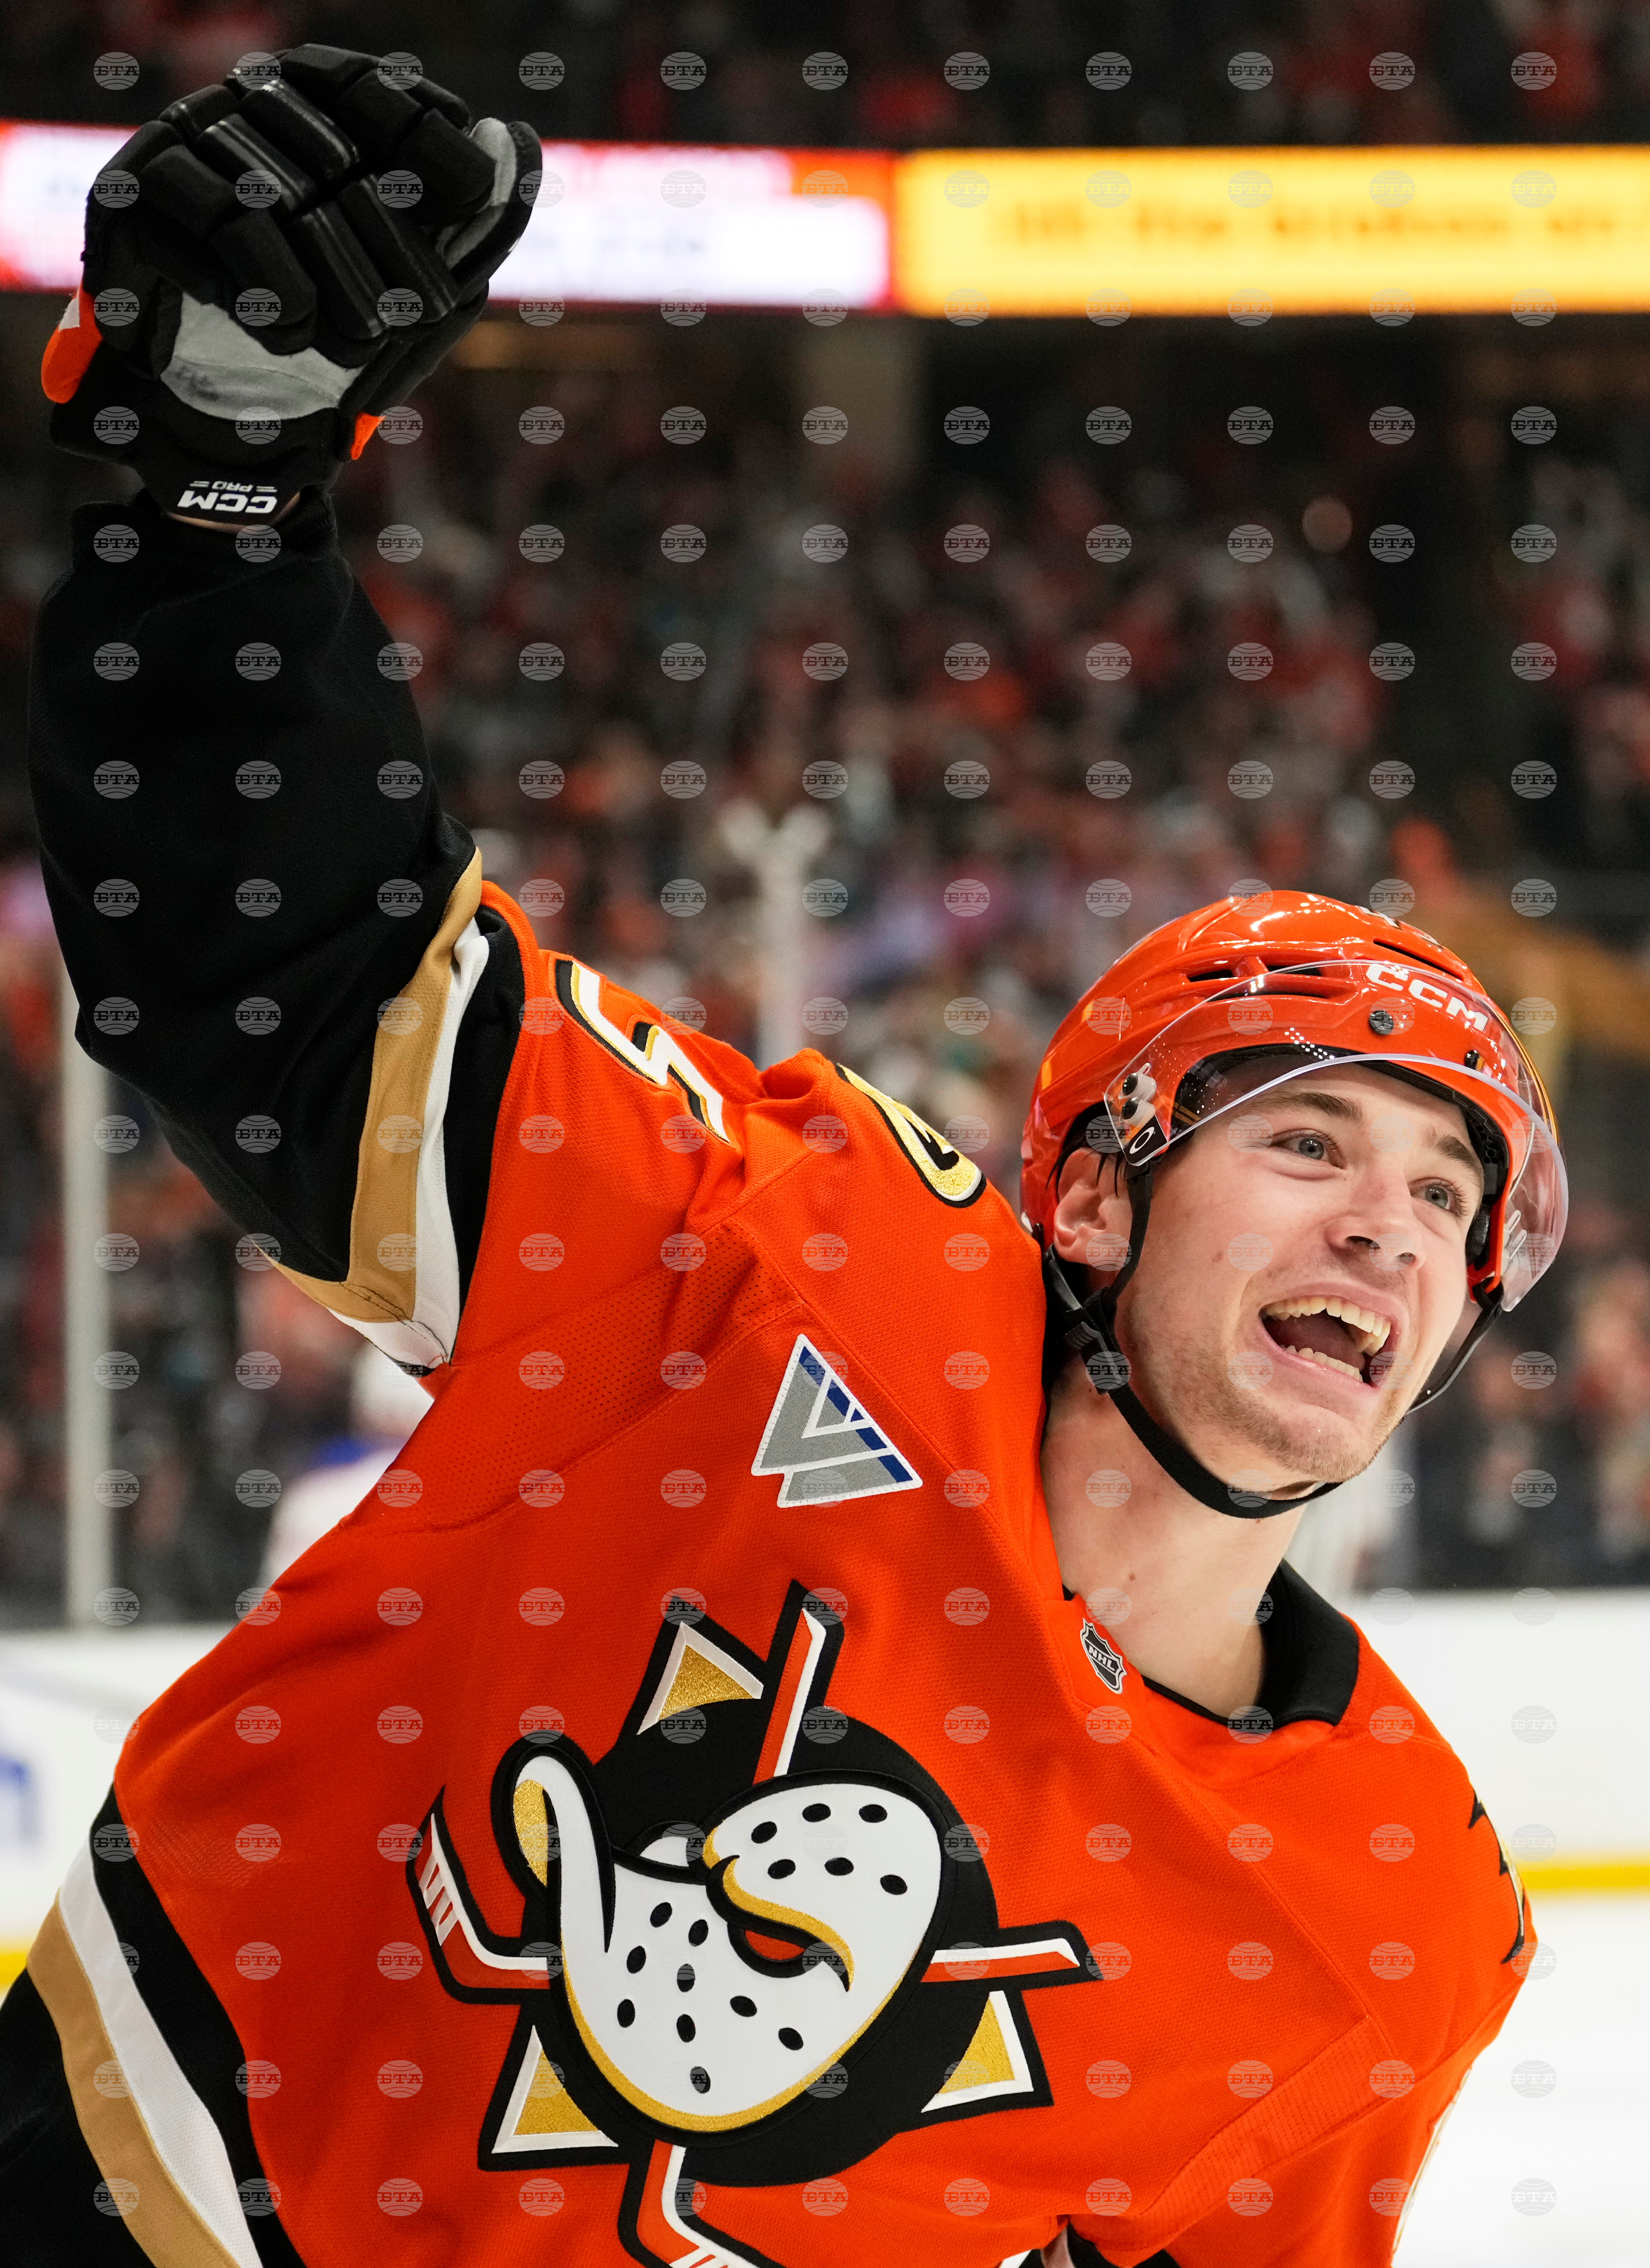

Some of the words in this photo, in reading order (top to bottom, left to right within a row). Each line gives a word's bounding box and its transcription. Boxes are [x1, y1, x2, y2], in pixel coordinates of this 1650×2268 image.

[212, 480, 254, 492] PRO
[178, 490, 278, 513] CCM
[1366, 964, 1488, 1031] CCM
[1089, 1645, 1115, 1671] NHL
